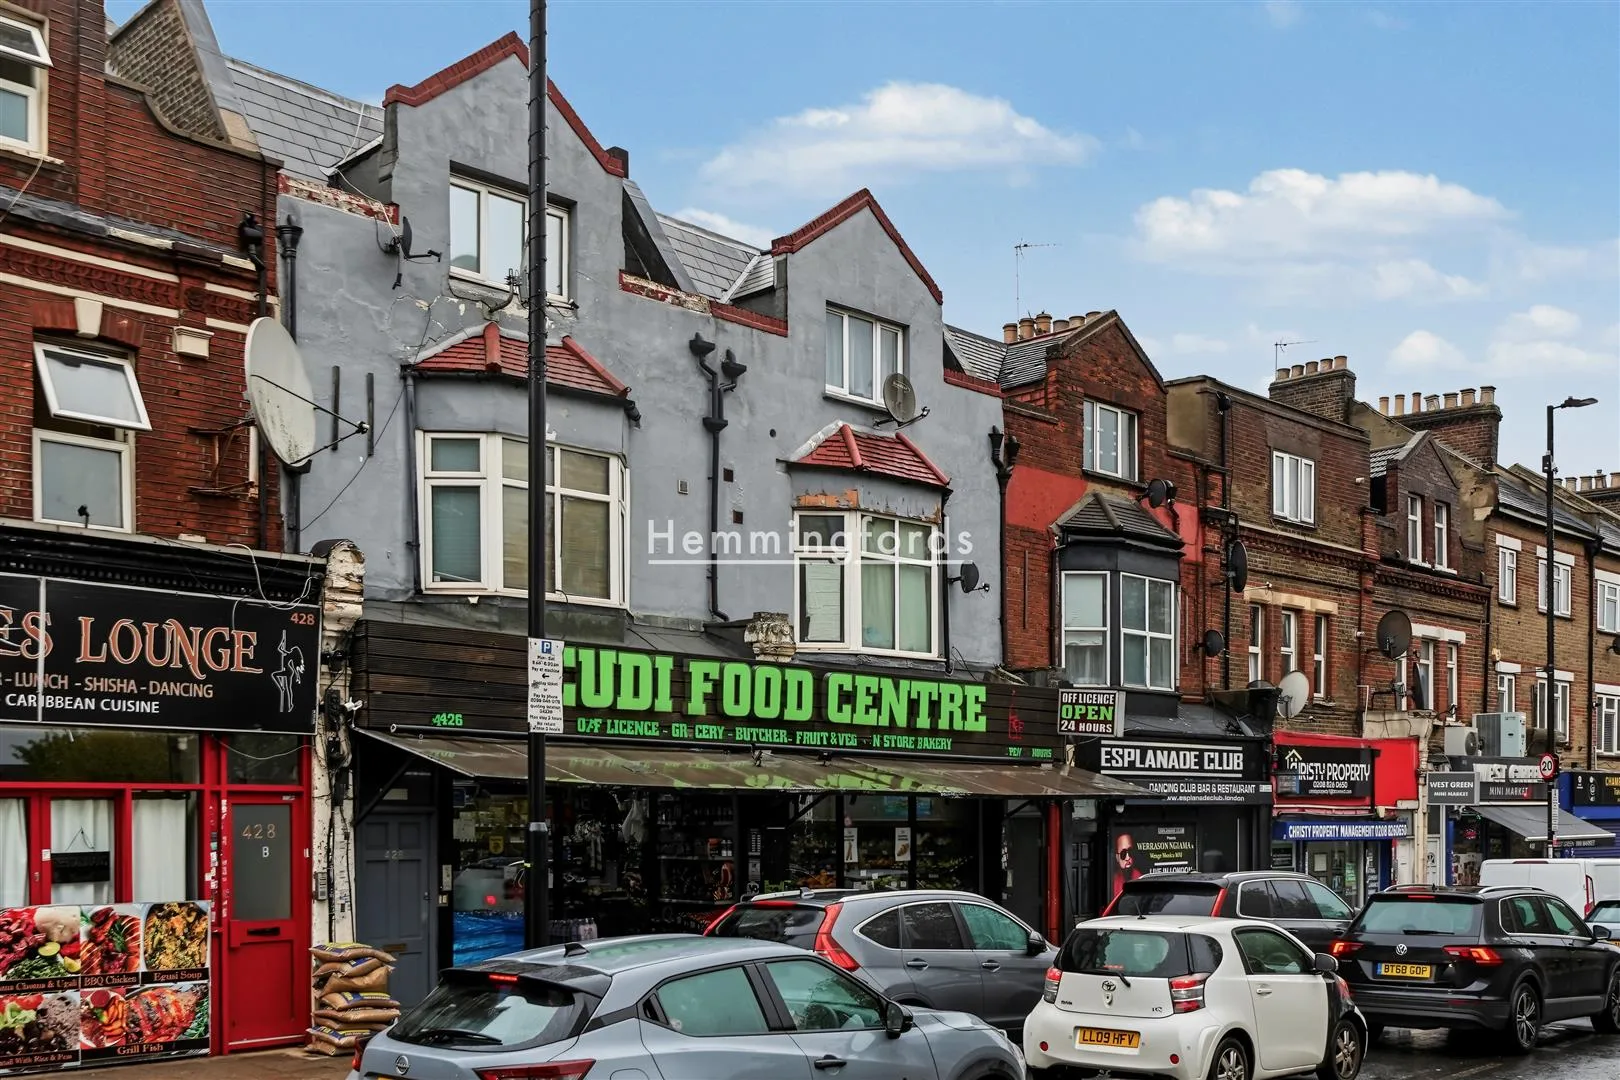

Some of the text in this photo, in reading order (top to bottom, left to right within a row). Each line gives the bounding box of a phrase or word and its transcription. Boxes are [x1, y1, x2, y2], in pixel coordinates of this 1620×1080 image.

[290, 612, 315, 626] 428
[76, 616, 263, 680] LOUNGE
[543, 641, 551, 653] P
[84, 676, 137, 694] SHISHA
[149, 680, 213, 699] DANCING
[686, 660, 814, 721] FOOD
[827, 672, 987, 732] CENTRE
[1062, 693, 1115, 705] OFF LICENCE
[5, 693, 160, 714] CARIBBEAN CUISINE
[1061, 704, 1114, 721] OPEN
[1061, 719, 1112, 733] 24 HOURS
[606, 718, 660, 736] LICENCE
[796, 731, 829, 746] FRUIT
[884, 735, 915, 749] STORE
[917, 737, 953, 750] BAKERY
[1100, 747, 1244, 771] ESPLANADE CLUB
[1542, 760, 1552, 771] 20
[1327, 763, 1370, 781] PROPERTY
[1149, 782, 1178, 793] DANCING
[1179, 783, 1196, 793] CLUB
[1197, 783, 1211, 793] BAR
[1212, 784, 1217, 793] &
[1217, 783, 1256, 794] RESTAURANT
[1489, 786, 1504, 796] MINI
[242, 823, 276, 839] 428
[1288, 825, 1312, 838] CHRISTY
[1312, 825, 1339, 838] PROPERTY
[1340, 825, 1375, 837] MANAGEMENT
[1375, 825, 1387, 836] 0208
[262, 846, 270, 858] B
[1384, 964, 1407, 974] BT68
[84, 974, 137, 986] BBQ Chicken
[154, 971, 202, 982] Egusi Soup
[1082, 1030, 1135, 1046] LL09 HFV
[116, 1044, 164, 1055] Grill Fish
